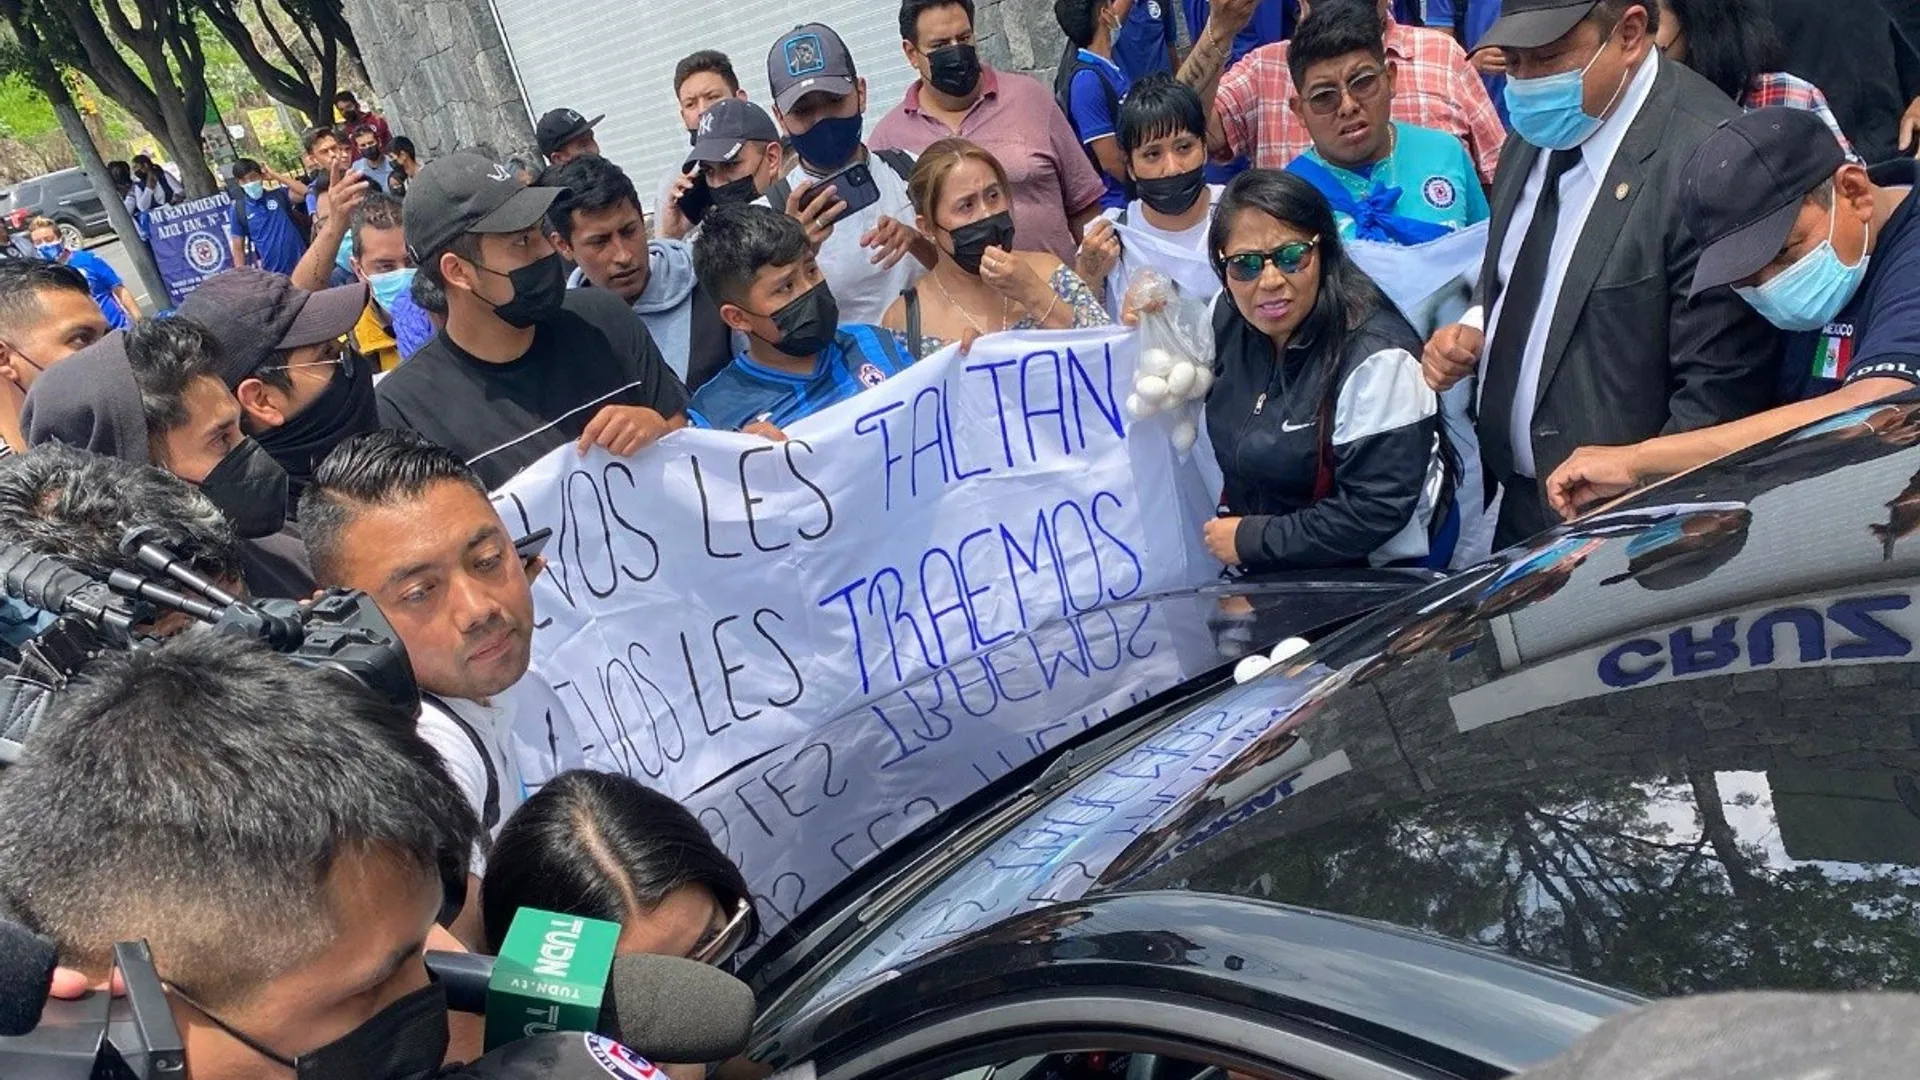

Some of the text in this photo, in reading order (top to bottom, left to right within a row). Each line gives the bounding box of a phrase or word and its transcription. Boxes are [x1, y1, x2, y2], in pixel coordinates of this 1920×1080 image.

[149, 191, 230, 224] MI SENTIMIENTO
[158, 222, 183, 240] AZUL
[223, 210, 230, 222] 1
[1822, 323, 1854, 337] MEXICO
[1843, 362, 1920, 386] DAL
[691, 439, 833, 558] LES
[854, 342, 1126, 511] FALTAN
[680, 608, 804, 736] LES
[819, 491, 1143, 694] TRAEMOS
[533, 919, 584, 978] TUDN
